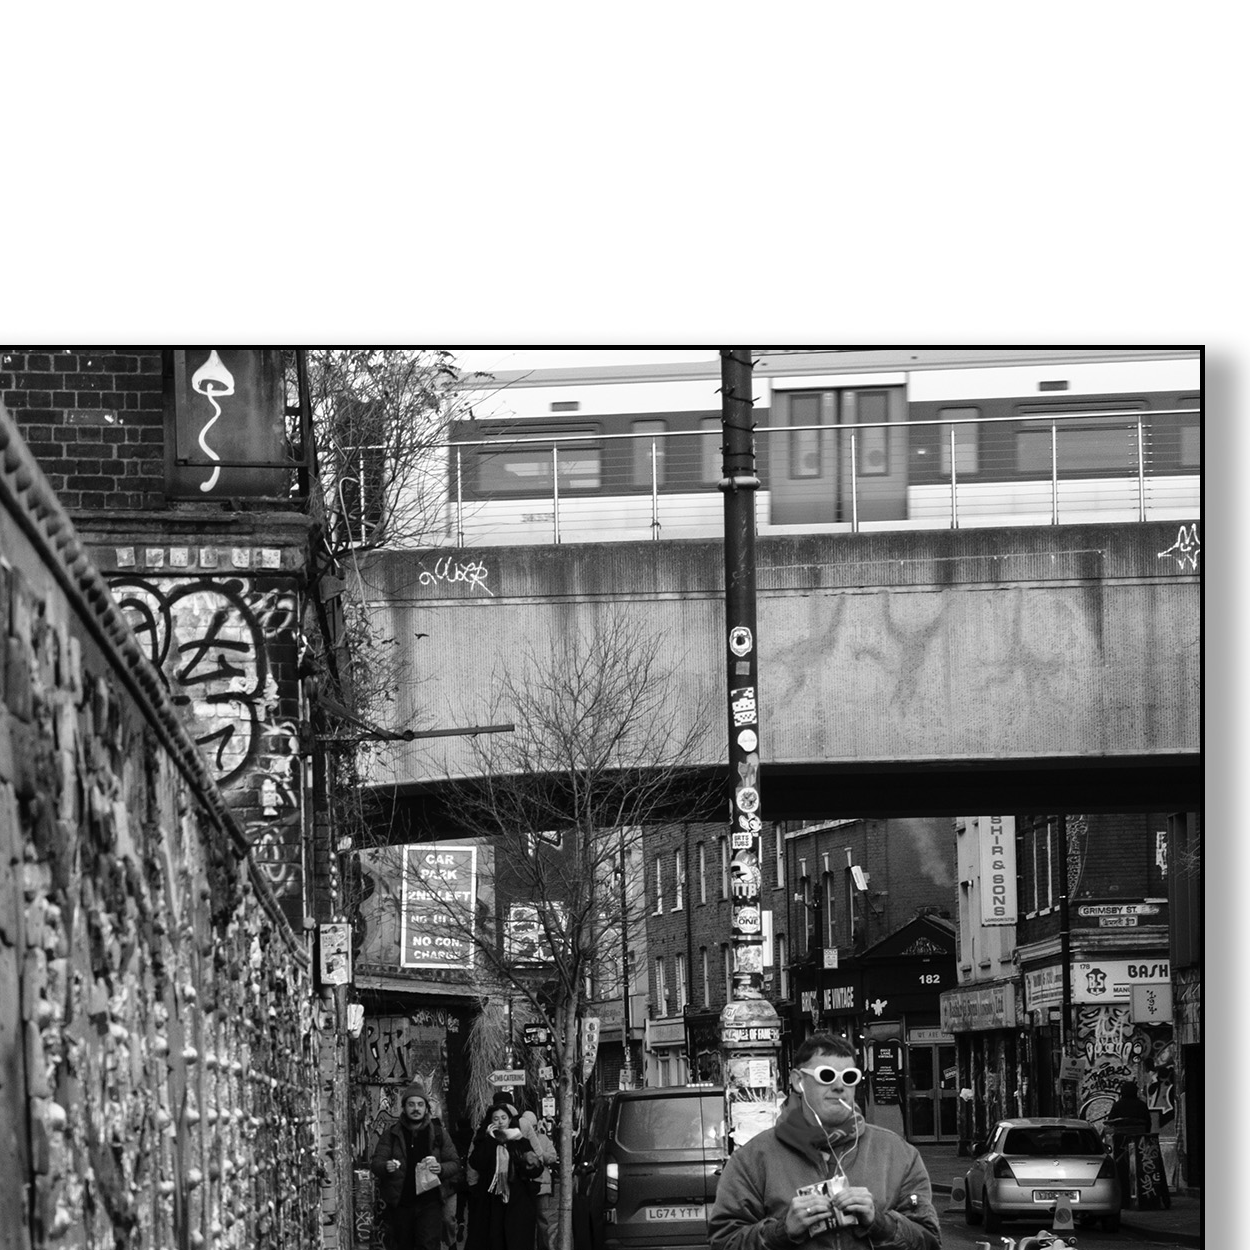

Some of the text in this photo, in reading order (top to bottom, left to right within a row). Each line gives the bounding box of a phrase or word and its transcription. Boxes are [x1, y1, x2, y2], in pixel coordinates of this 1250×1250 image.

[425, 854, 454, 865] CAR
[420, 869, 457, 880] PARK
[408, 890, 471, 901] 2ND LEFT
[993, 874, 1005, 916] SONS
[1083, 906, 1123, 915] GRIMSBY
[1126, 906, 1138, 914] ST.
[412, 936, 463, 947] NO CON.
[1127, 964, 1169, 978] BASH
[918, 974, 940, 984] 182
[503, 1073, 525, 1082] CATERING
[649, 1207, 700, 1219] LG74 YTT
